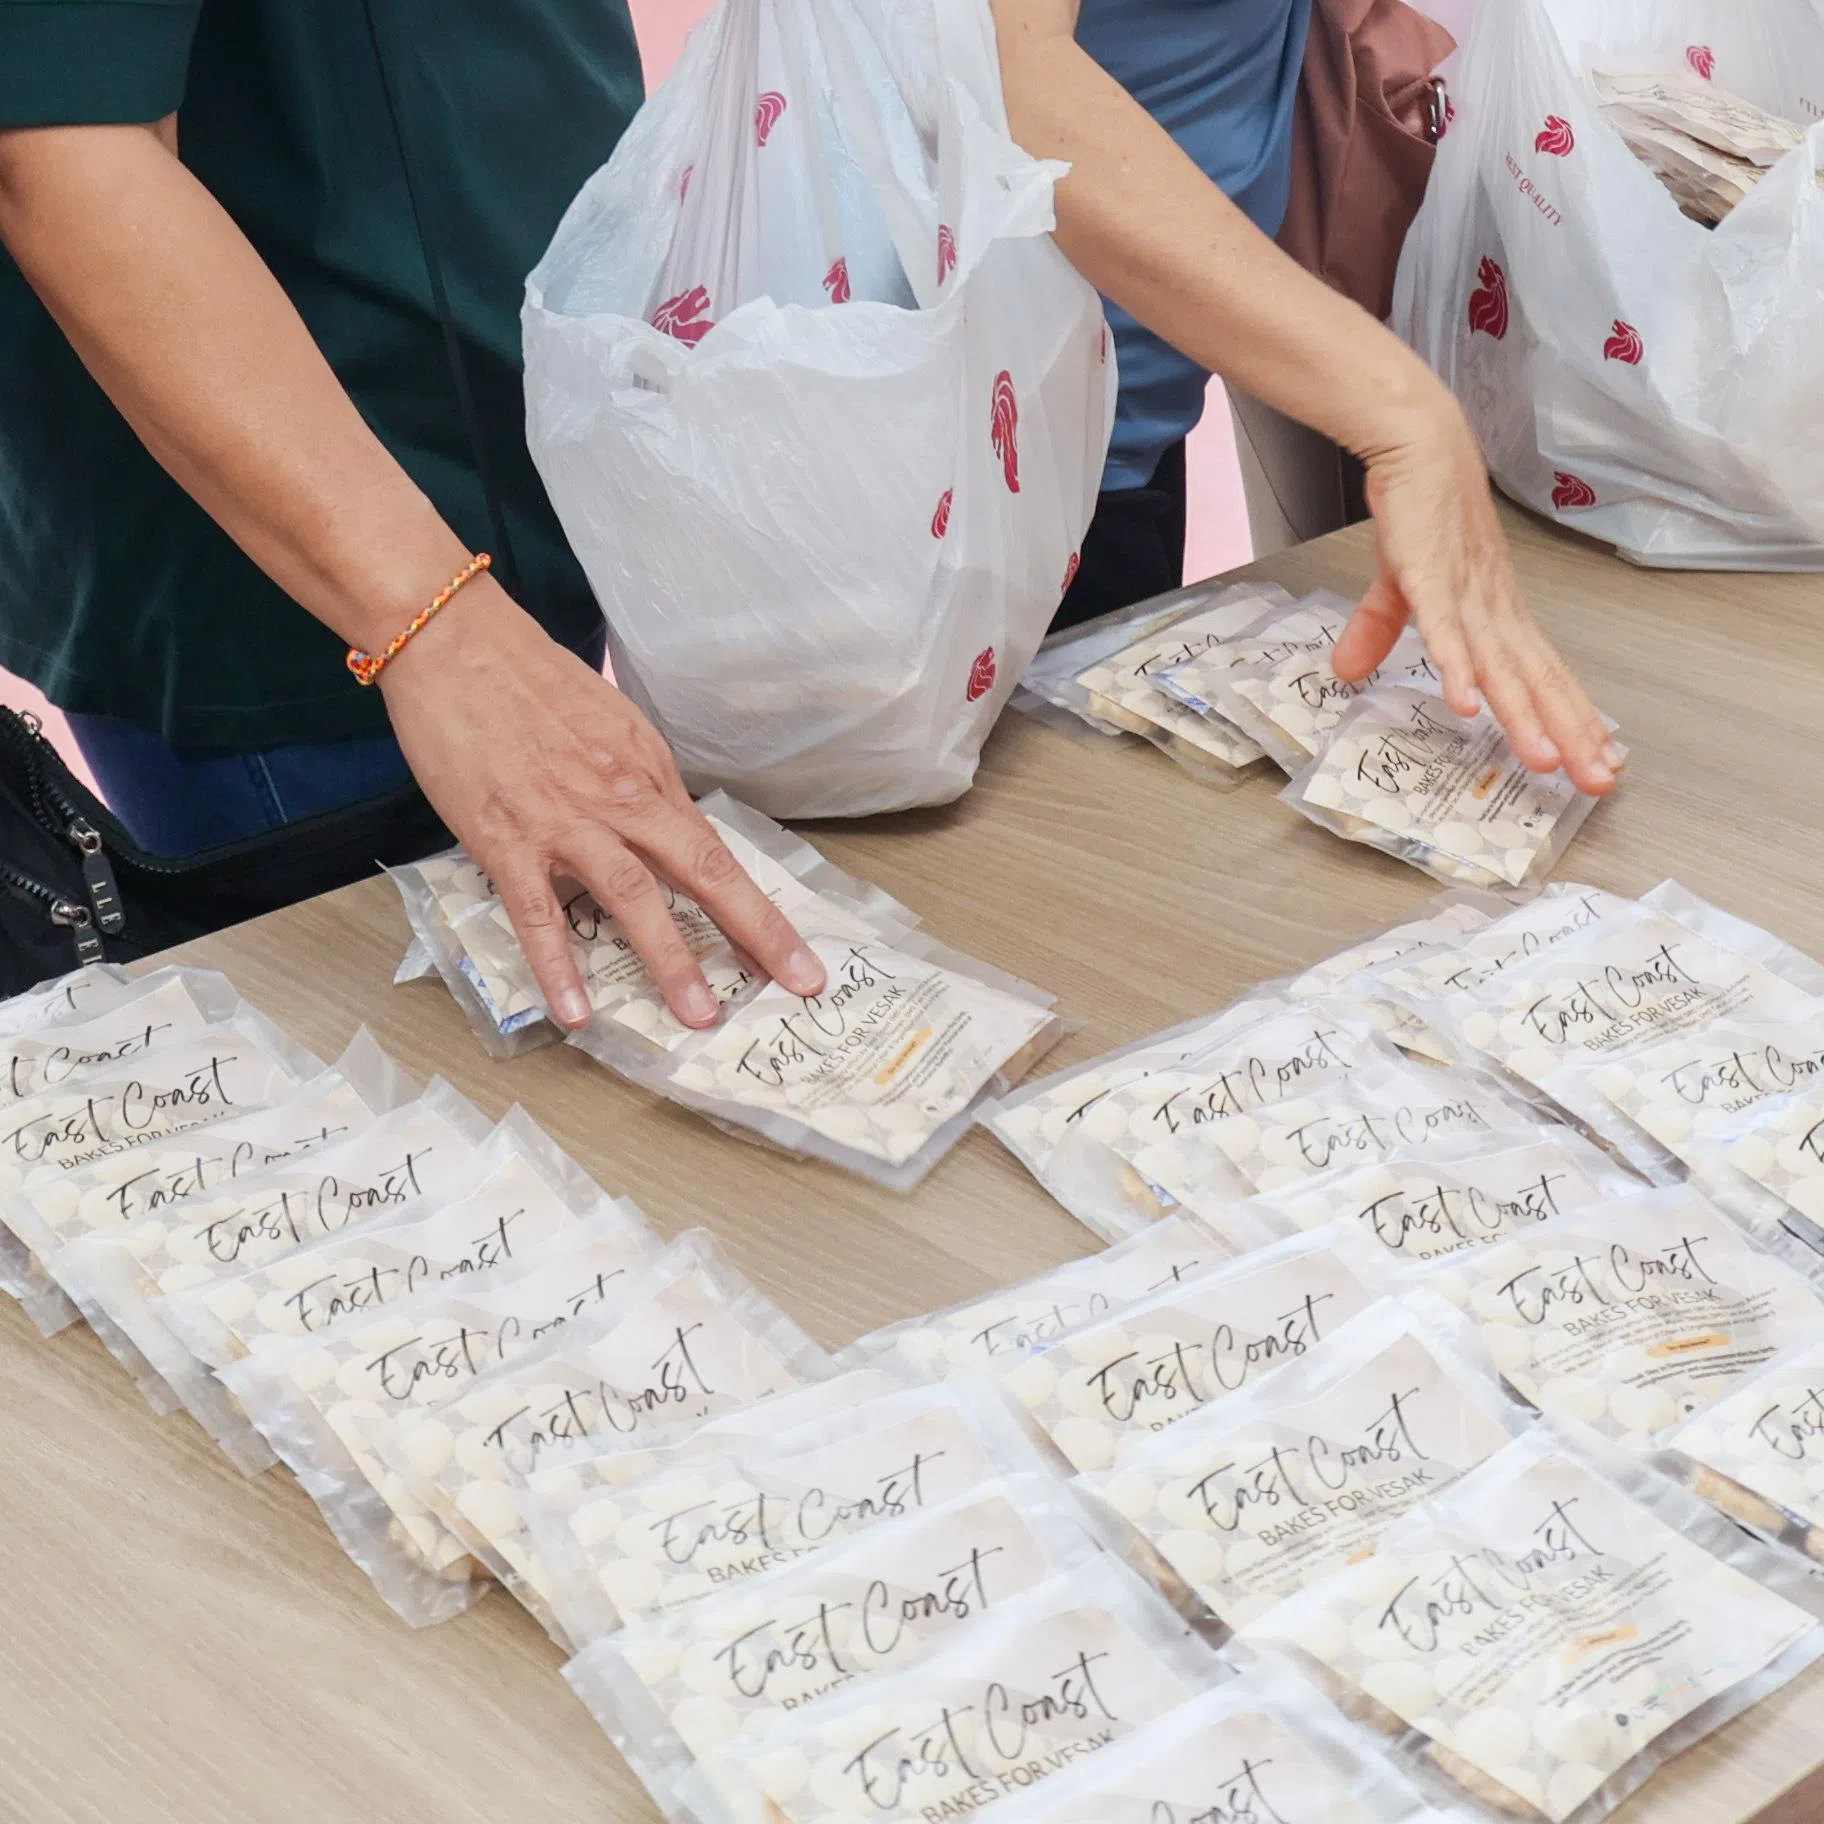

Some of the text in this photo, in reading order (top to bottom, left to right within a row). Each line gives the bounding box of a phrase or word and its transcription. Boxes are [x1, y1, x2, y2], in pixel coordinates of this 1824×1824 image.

[1518, 177, 1564, 226] QUALITY
[1358, 732, 1431, 794] East
[1412, 765, 1449, 796] BAKES
[735, 1012, 826, 1089] East
[802, 946, 897, 1038] Coast
[837, 1025, 871, 1056] FOR
[861, 983, 908, 1026] VESAK
[1520, 942, 1702, 1045] East Coast
[1582, 983, 1707, 1052] BAKES FOR VESAK
[2, 1056, 238, 1162] East Coast
[1660, 1050, 1768, 1106] East
[57, 1137, 125, 1171] BAKES
[1285, 1116, 1388, 1170] East
[194, 1191, 312, 1262] East
[317, 1146, 434, 1232] Coast
[1359, 1173, 1568, 1251] East Coast
[1496, 1236, 1719, 1326] East Coast
[1563, 1287, 1723, 1338] BAKES FOR VESAK
[365, 1327, 488, 1402] East
[1087, 1293, 1335, 1422] East Coast
[483, 1322, 717, 1474] East Coast
[1187, 1385, 1432, 1533] East Coast
[649, 1450, 946, 1565] East Coast
[1257, 1466, 1435, 1548] BAKES FOR VESAK
[1378, 1495, 1606, 1654] East Coast
[1550, 1563, 1618, 1610] VESAK
[712, 1545, 1005, 1699] East Coast
[842, 1651, 1120, 1811] East Coast
[919, 1782, 998, 1824] BAKES
[997, 1758, 1048, 1791] FOR
